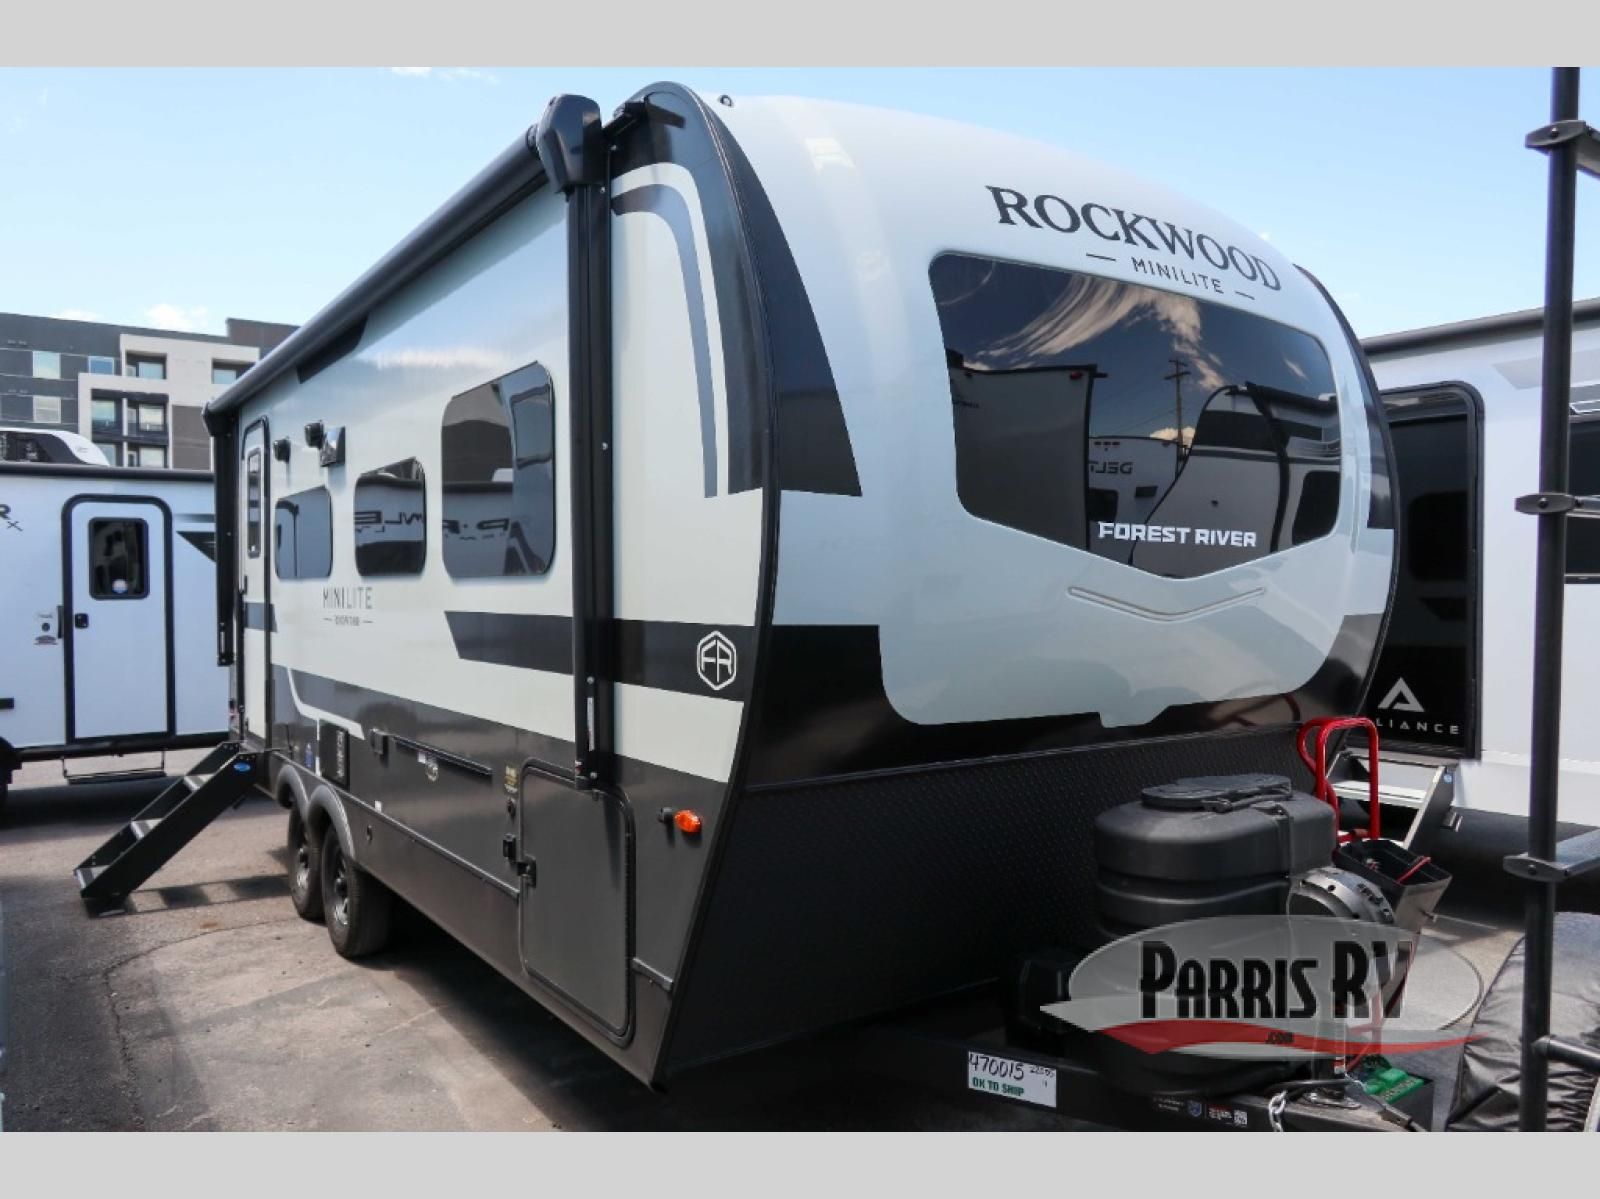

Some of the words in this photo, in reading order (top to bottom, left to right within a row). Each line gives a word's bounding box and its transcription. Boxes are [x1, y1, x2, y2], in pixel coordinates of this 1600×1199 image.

[985, 185, 1282, 292] ROCKWOOD
[1131, 256, 1225, 295] MINILITE
[1098, 521, 1191, 545] FOREST
[1195, 528, 1258, 548] RIVER
[322, 586, 373, 610] MINILITE
[1376, 717, 1460, 735] LIANCE
[968, 1053, 1025, 1081] 470015
[972, 1075, 985, 1088] OK
[987, 1080, 999, 1092] TO
[1001, 1083, 1025, 1097] SHIP
